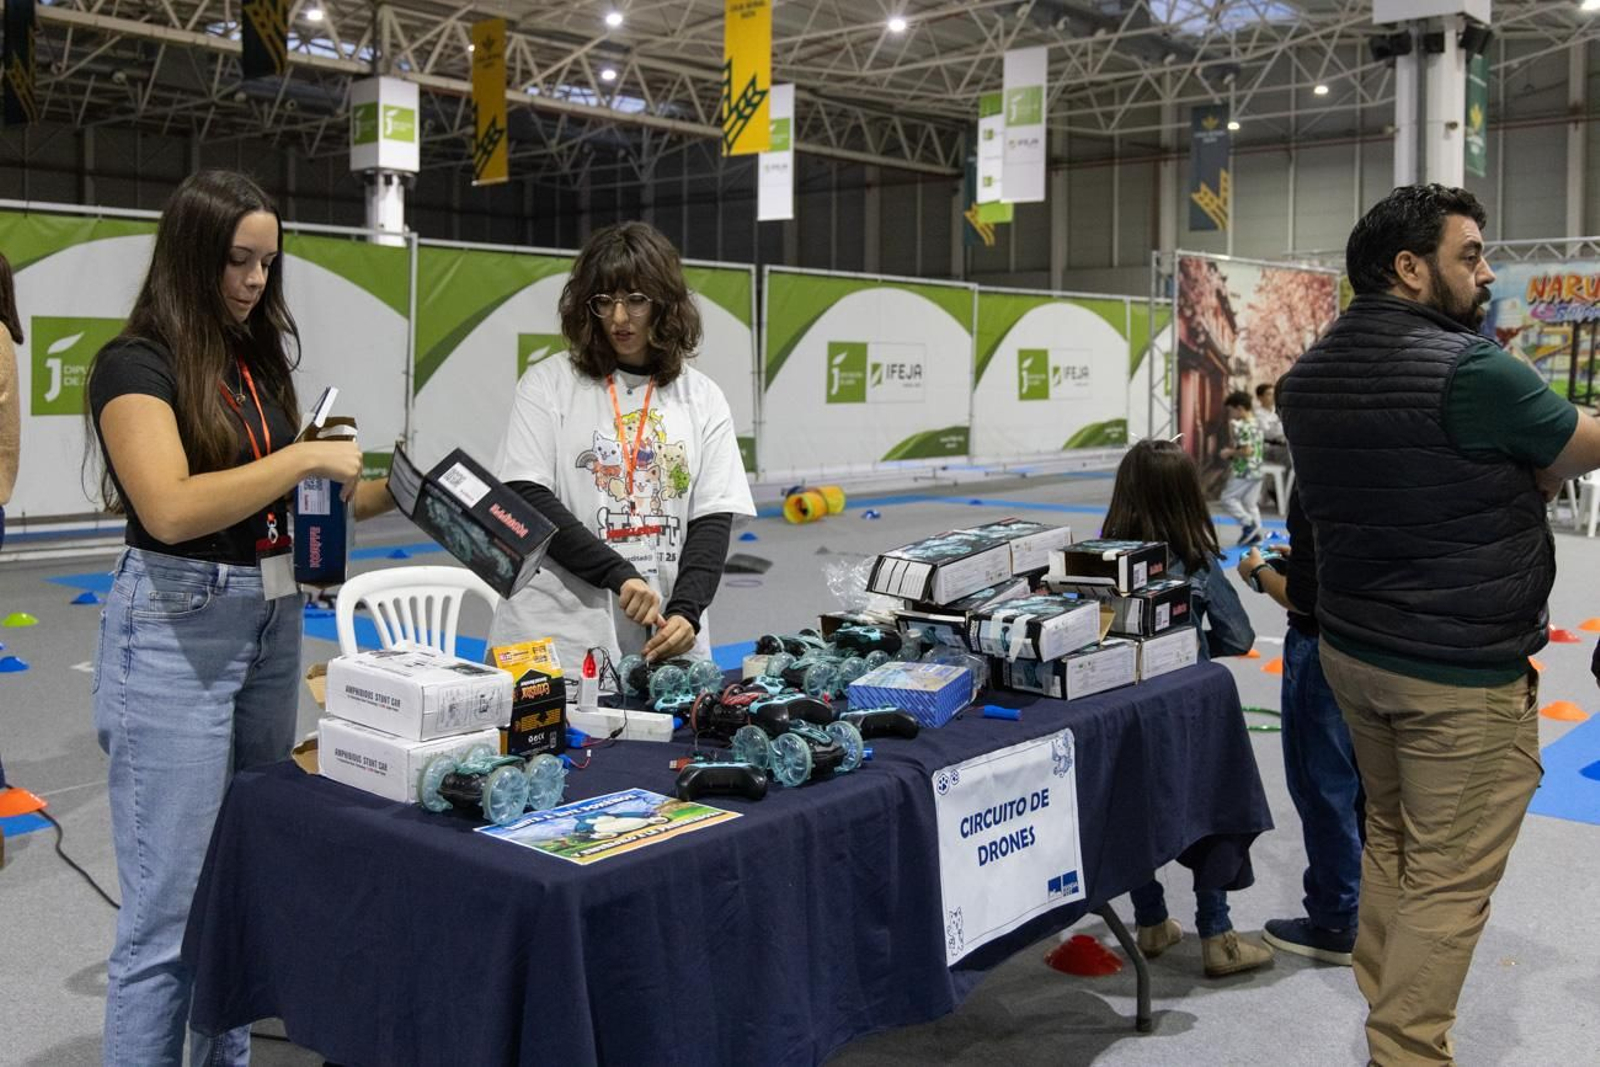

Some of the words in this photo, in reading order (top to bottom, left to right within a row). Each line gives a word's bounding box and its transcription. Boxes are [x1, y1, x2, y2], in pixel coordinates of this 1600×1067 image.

[886, 363, 922, 380] IFEJA
[345, 684, 374, 700] AMPHIBIOUS
[375, 692, 391, 704] STUNT
[391, 697, 401, 708] CAR
[334, 747, 362, 763] AMPHIBIOUS
[362, 754, 378, 767] STUNT
[378, 760, 388, 771] CAR
[960, 797, 1027, 839] CIRCUITO
[1030, 788, 1050, 812] DE
[978, 825, 1036, 866] DRONES
